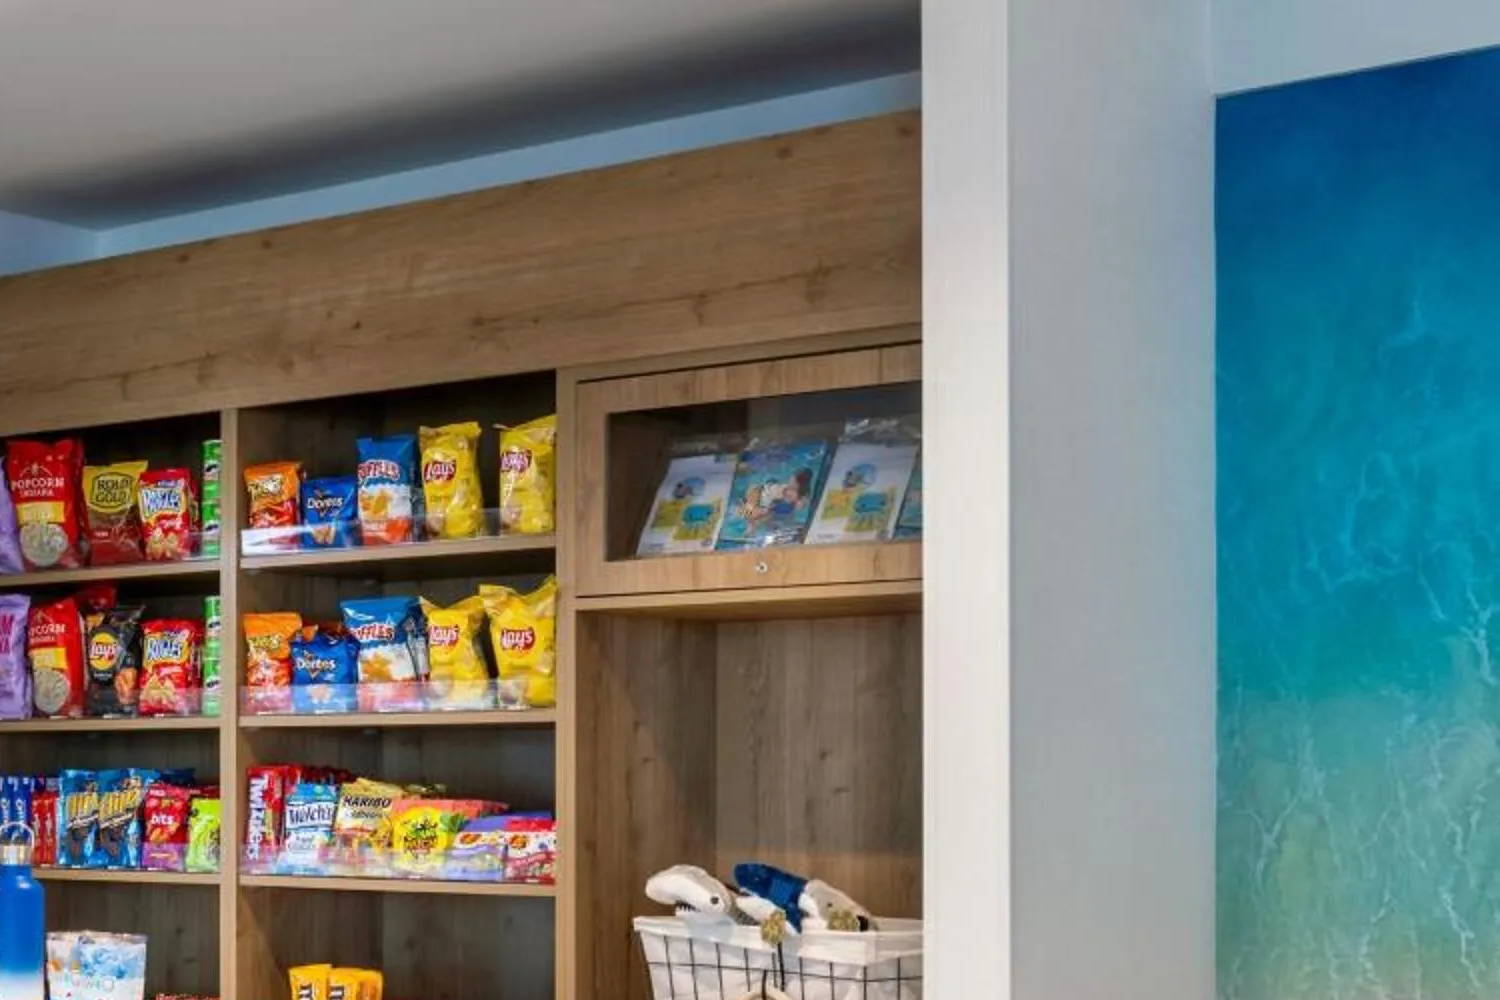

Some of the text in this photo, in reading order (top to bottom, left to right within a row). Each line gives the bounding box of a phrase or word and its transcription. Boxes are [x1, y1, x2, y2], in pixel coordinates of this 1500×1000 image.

[11, 477, 64, 492] POPCORN
[296, 657, 337, 671] Doritos
[343, 796, 393, 808] HARIBO
[150, 812, 175, 826] bits
